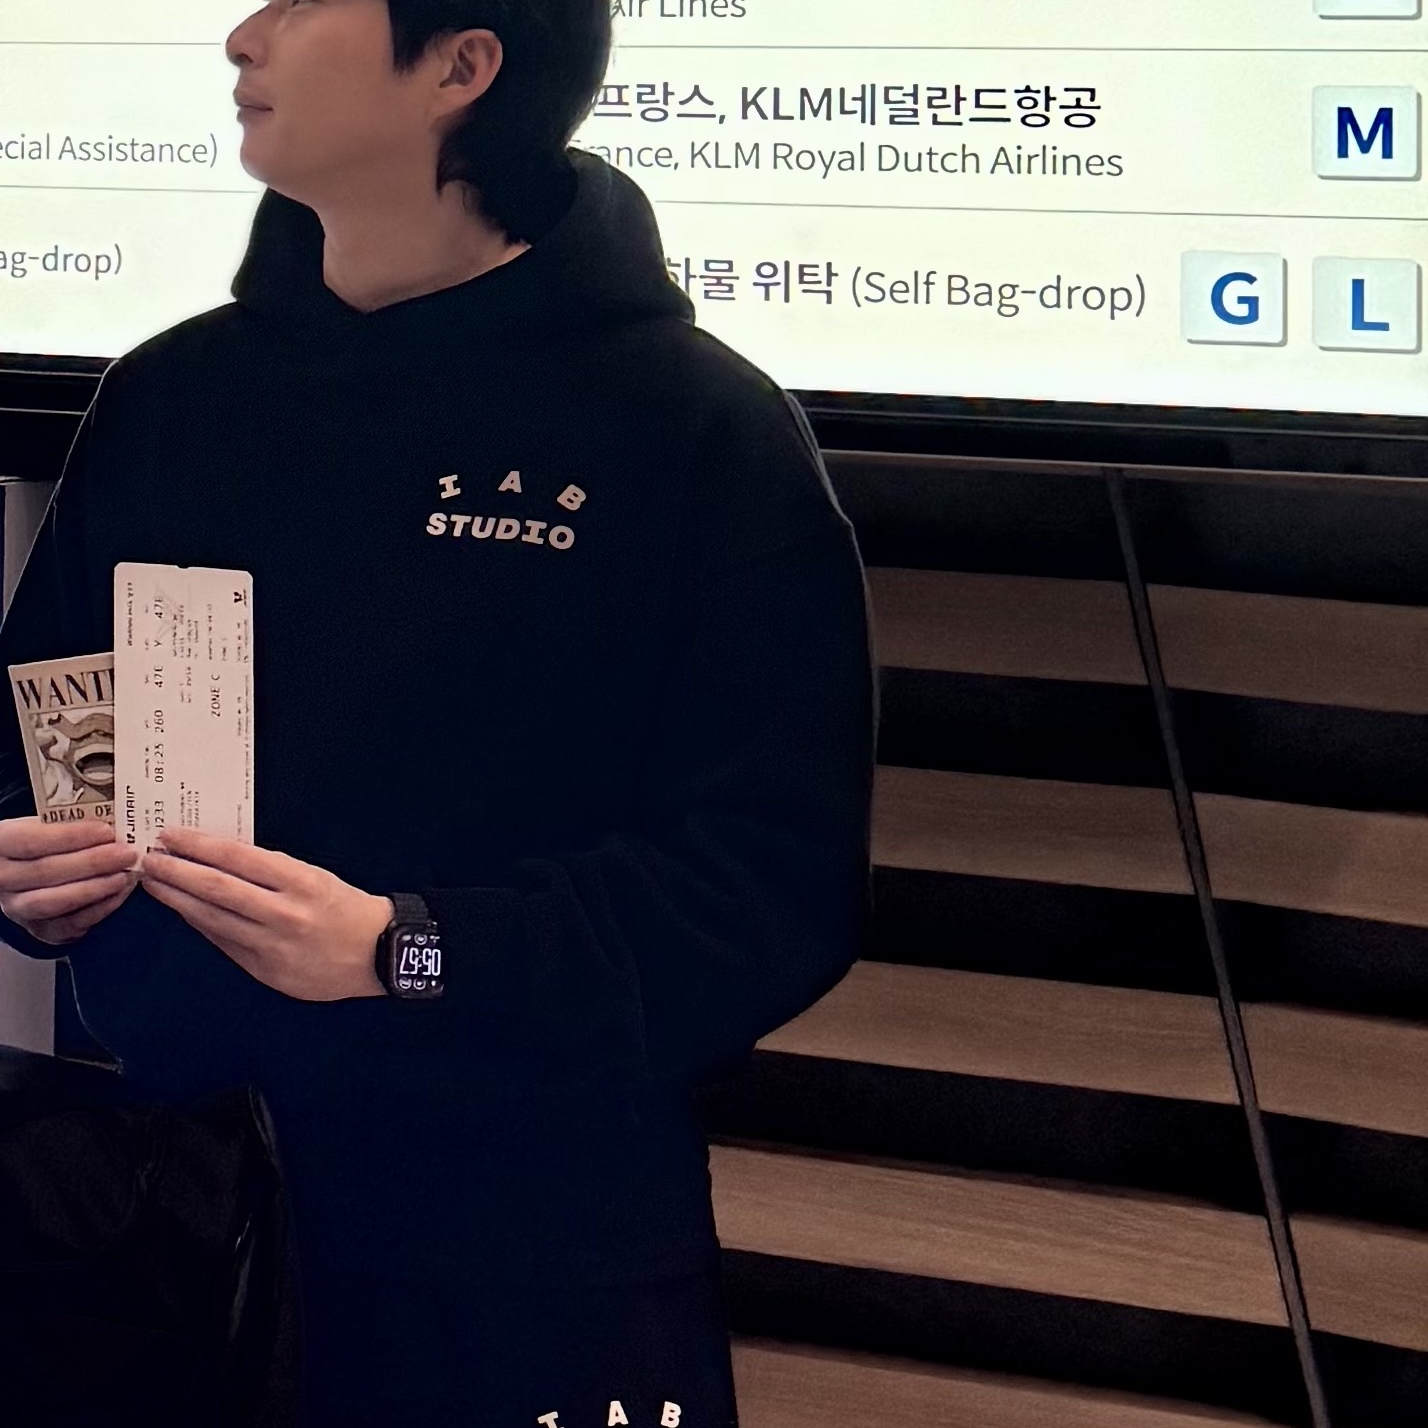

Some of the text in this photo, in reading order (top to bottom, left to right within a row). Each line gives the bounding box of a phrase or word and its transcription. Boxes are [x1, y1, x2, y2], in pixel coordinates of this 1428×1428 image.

[593, 81, 1102, 130] 프랑스, KLM네덜란드항공
[58, 133, 217, 168] Assistance)
[1337, 107, 1393, 159] M
[691, 141, 759, 169] KLM
[773, 142, 864, 179] Royal
[878, 143, 980, 173] Dutch
[990, 144, 1123, 176] Airlines
[752, 260, 839, 304] 위탁
[852, 266, 1148, 321] (Self Bag-drop)
[1211, 272, 1259, 325] G
[1352, 279, 1389, 331] L
[426, 513, 574, 549] STUDIO
[211, 684, 221, 718] ZONE
[154, 743, 165, 784] 08:25
